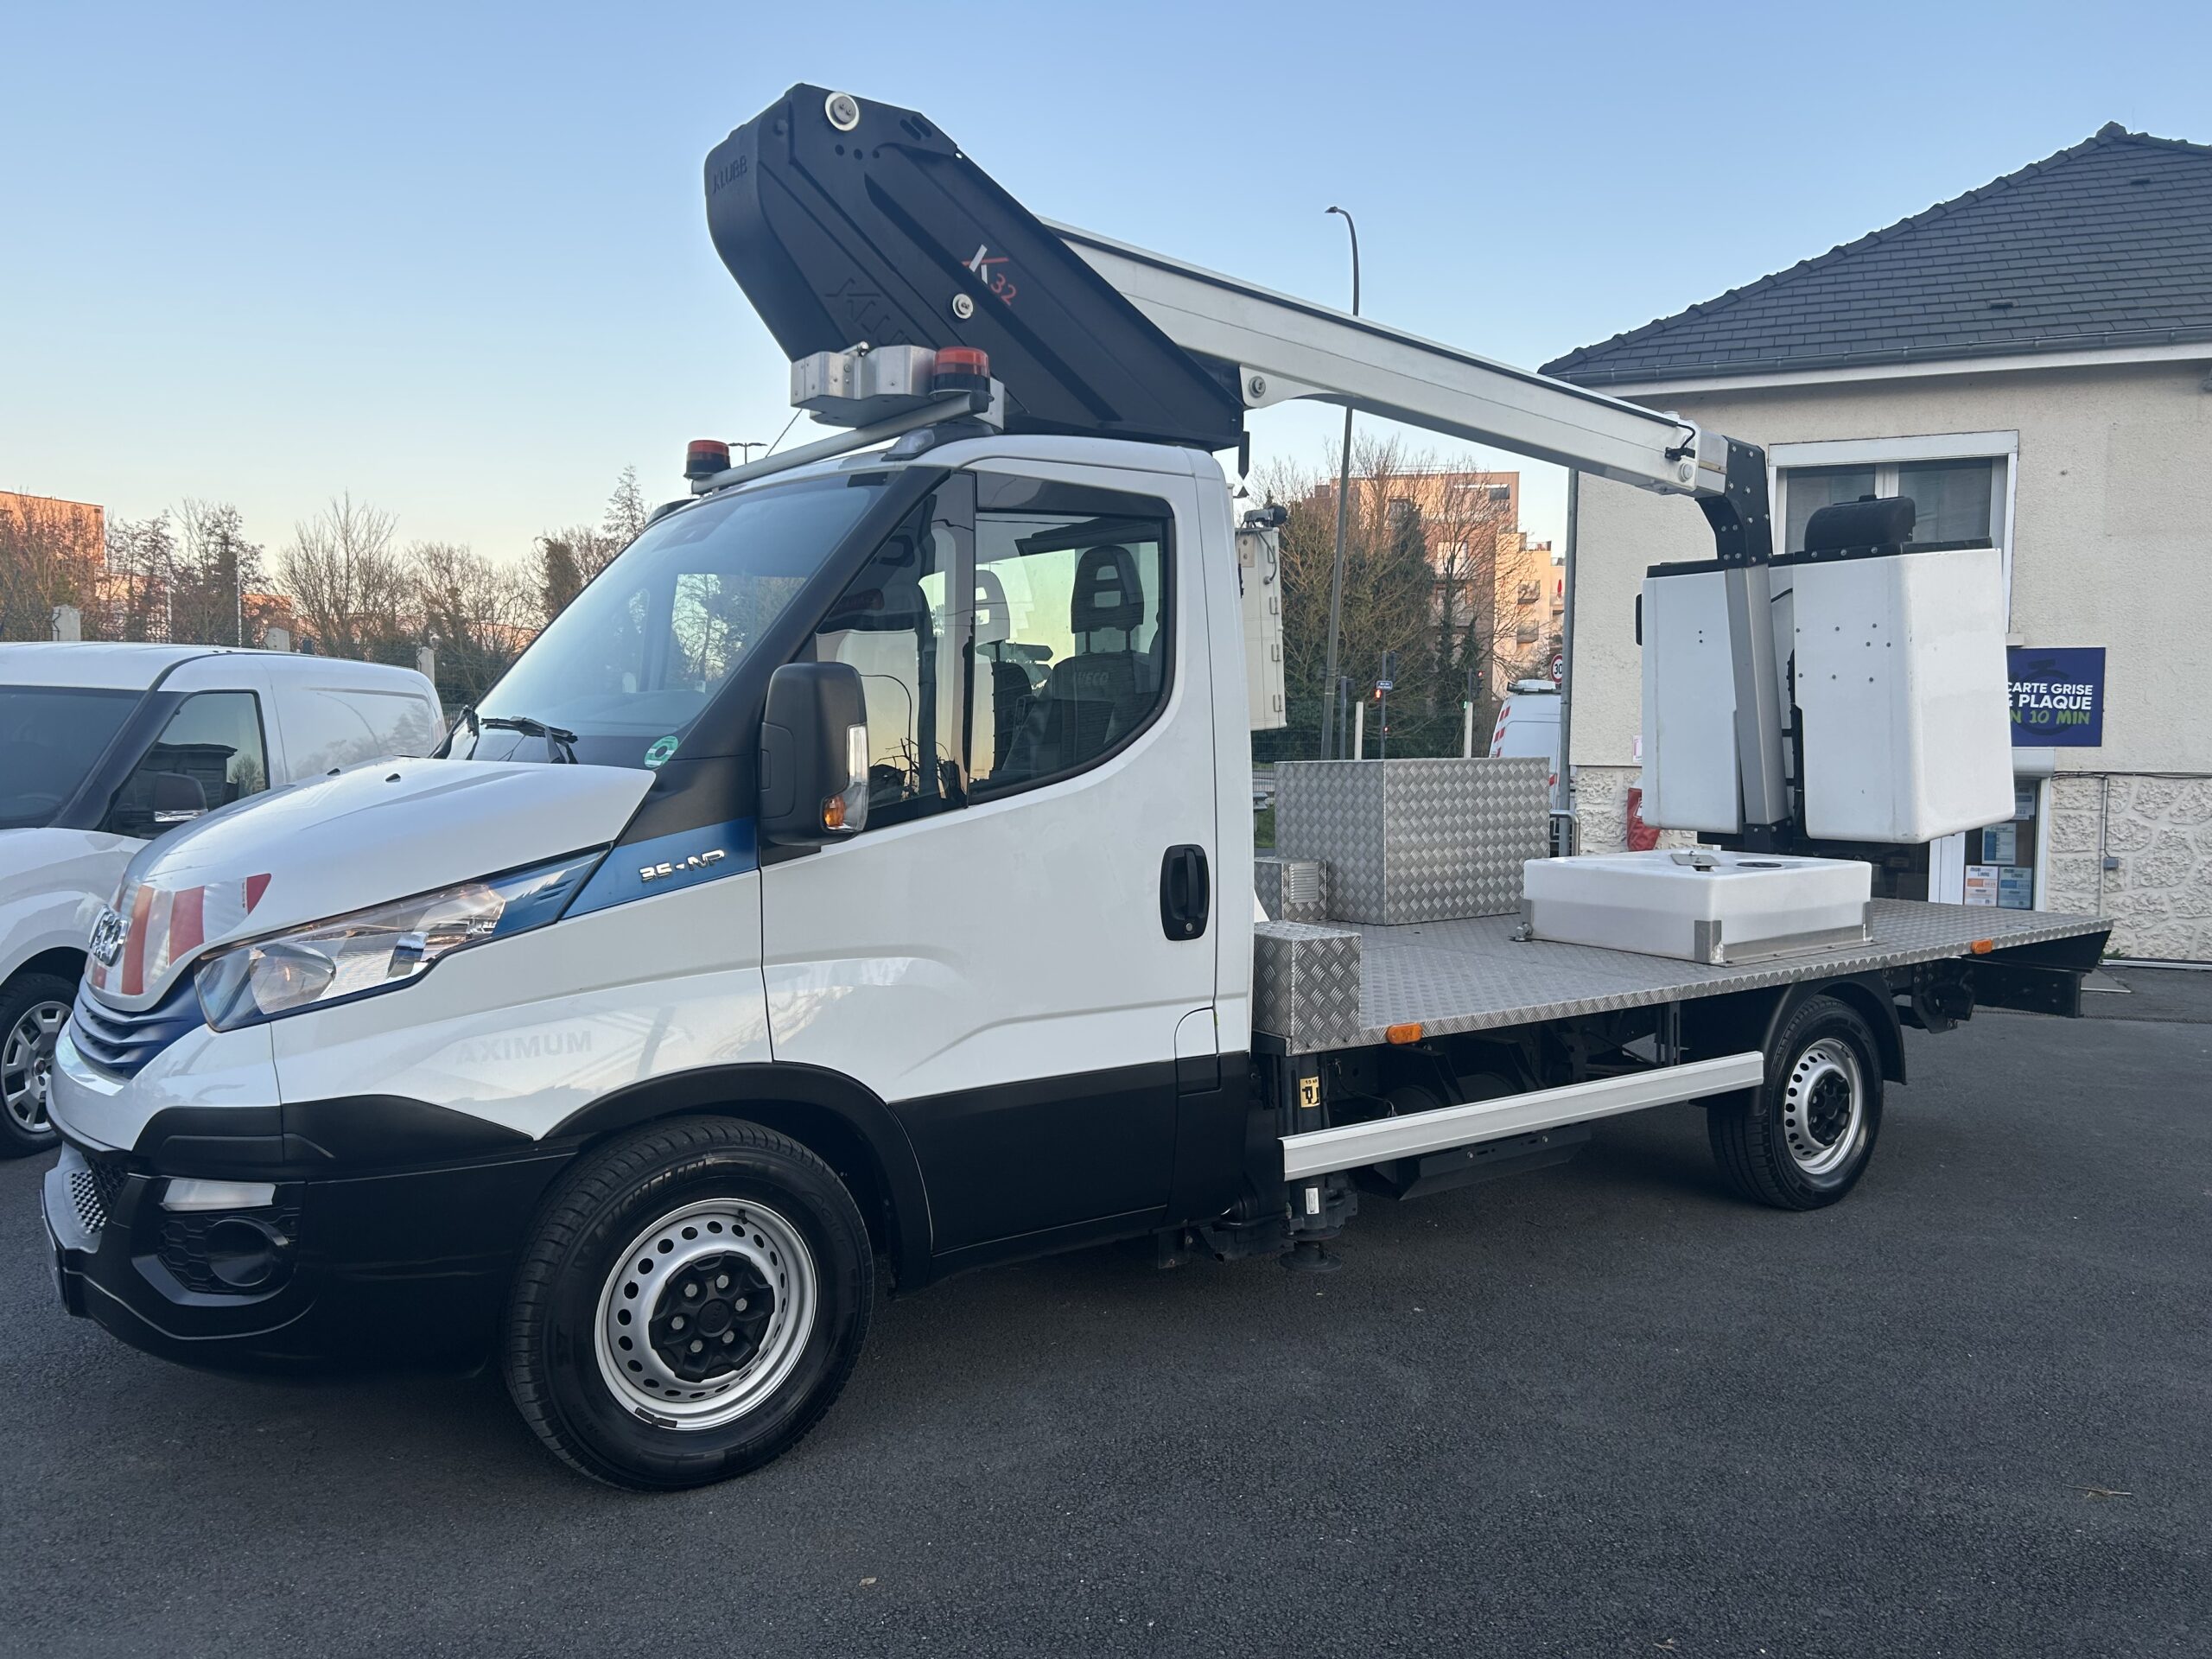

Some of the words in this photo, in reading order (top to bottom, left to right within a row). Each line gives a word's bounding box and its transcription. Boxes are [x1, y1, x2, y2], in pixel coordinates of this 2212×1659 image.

[713, 155, 748, 194] KLUBB
[1554, 663, 1562, 675] 30
[2050, 683, 2093, 696] GRISE
[2018, 694, 2092, 710] PLAQUE
[2029, 709, 2050, 724] 10
[2056, 709, 2090, 725] MIN
